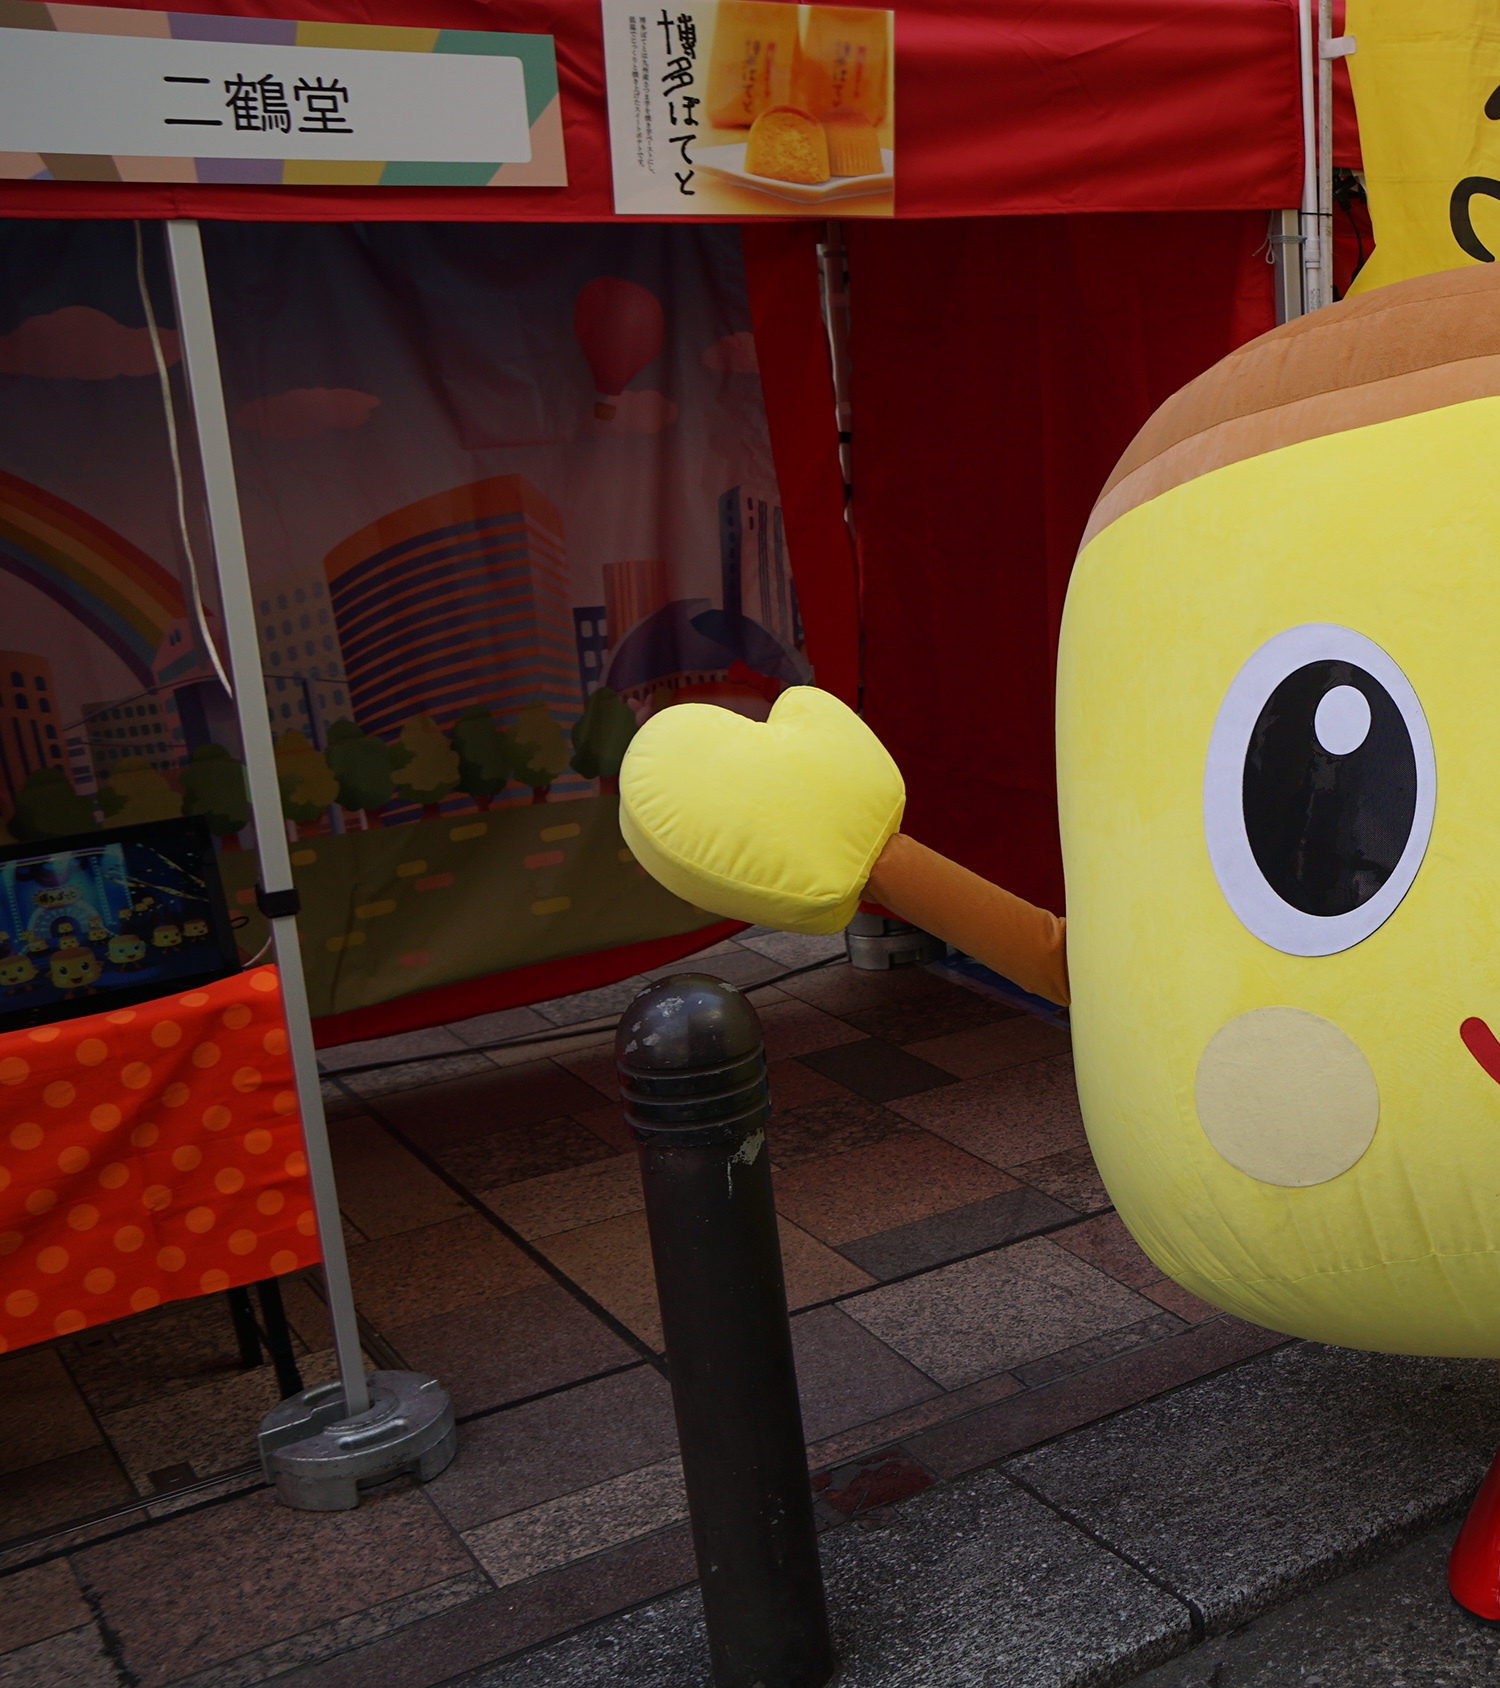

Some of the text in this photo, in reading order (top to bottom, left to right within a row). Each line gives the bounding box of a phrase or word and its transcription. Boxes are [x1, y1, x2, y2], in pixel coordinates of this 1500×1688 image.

[163, 73, 354, 134] 二鶴堂
[657, 9, 701, 196] 博多ぽてと
